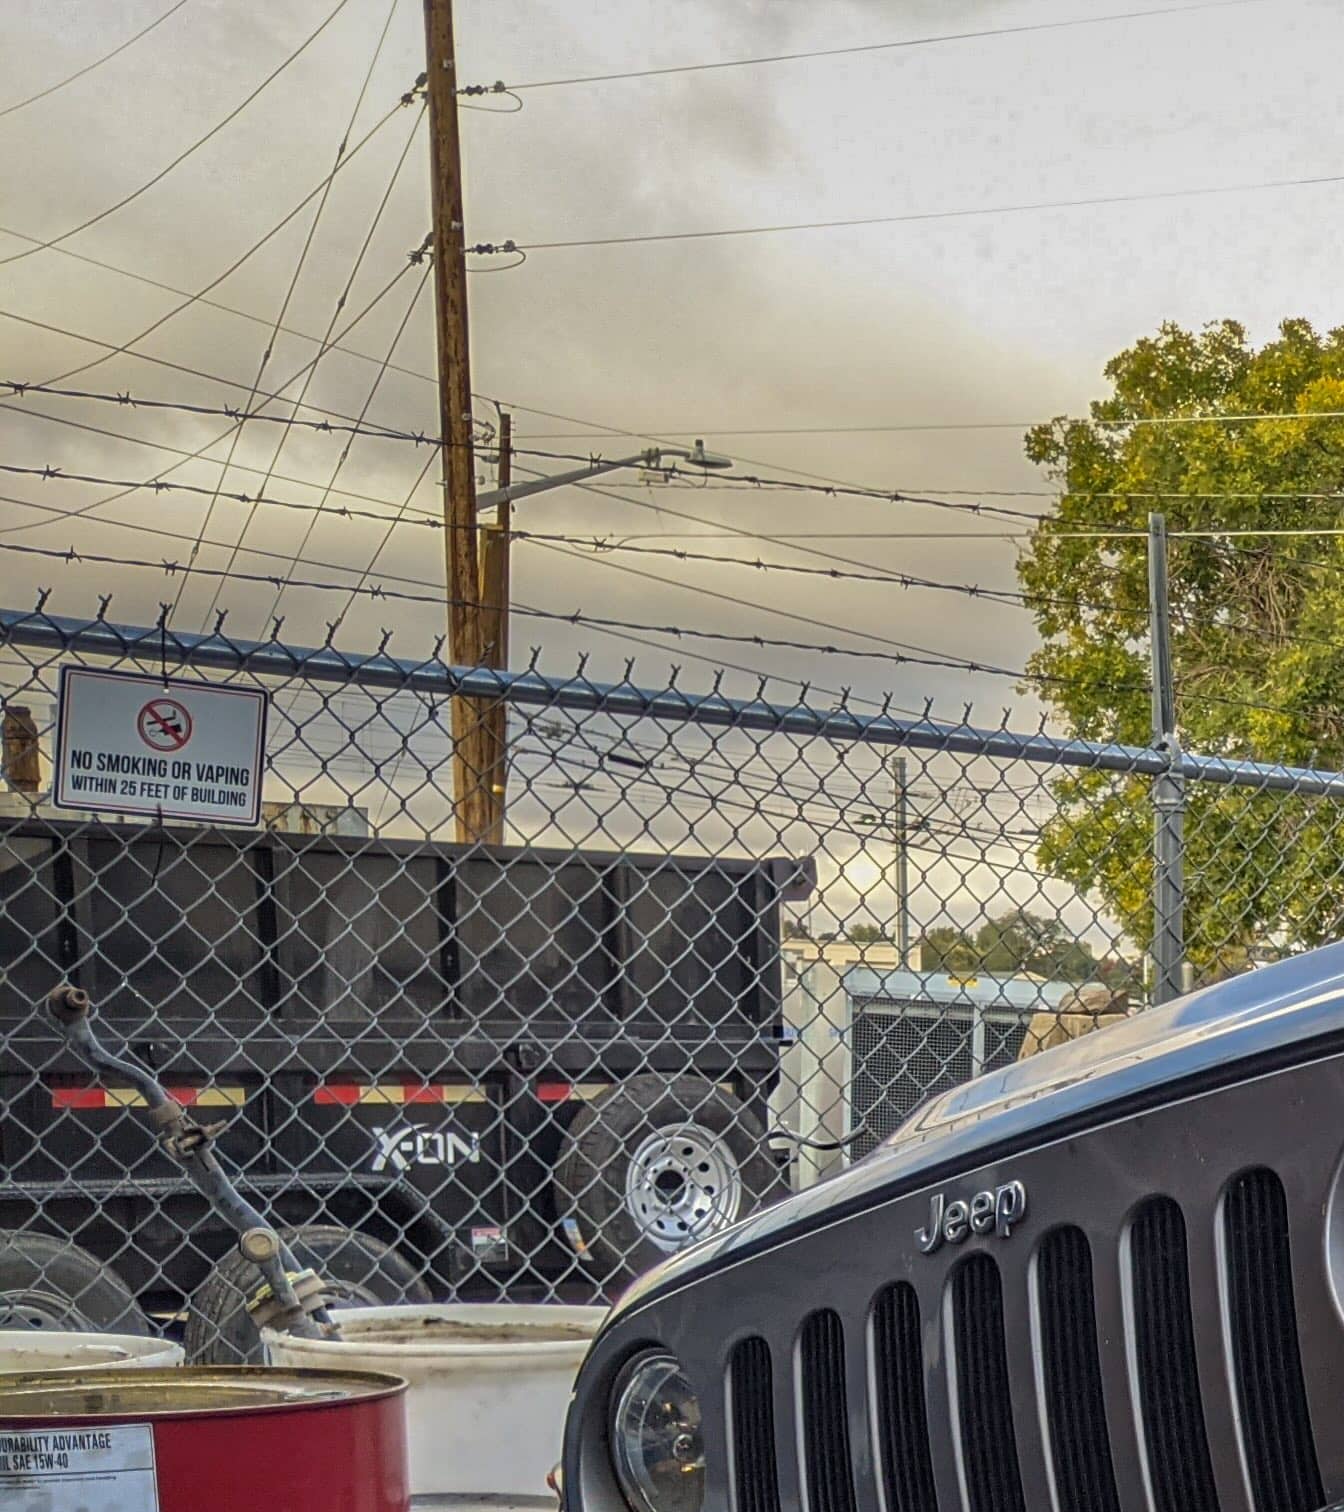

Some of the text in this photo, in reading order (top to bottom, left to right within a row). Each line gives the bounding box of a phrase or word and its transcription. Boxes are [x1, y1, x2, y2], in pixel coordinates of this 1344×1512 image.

[71, 750, 249, 786] NO SMOKING OR VAPING
[71, 774, 247, 808] WITHIN 25 FEET OF BUILDING
[914, 1179, 1027, 1253] Jeep
[0, 1432, 112, 1453] URABILITY ADVANTAGE
[13, 1454, 32, 1471] SAE
[34, 1452, 69, 1470] 15W-40
